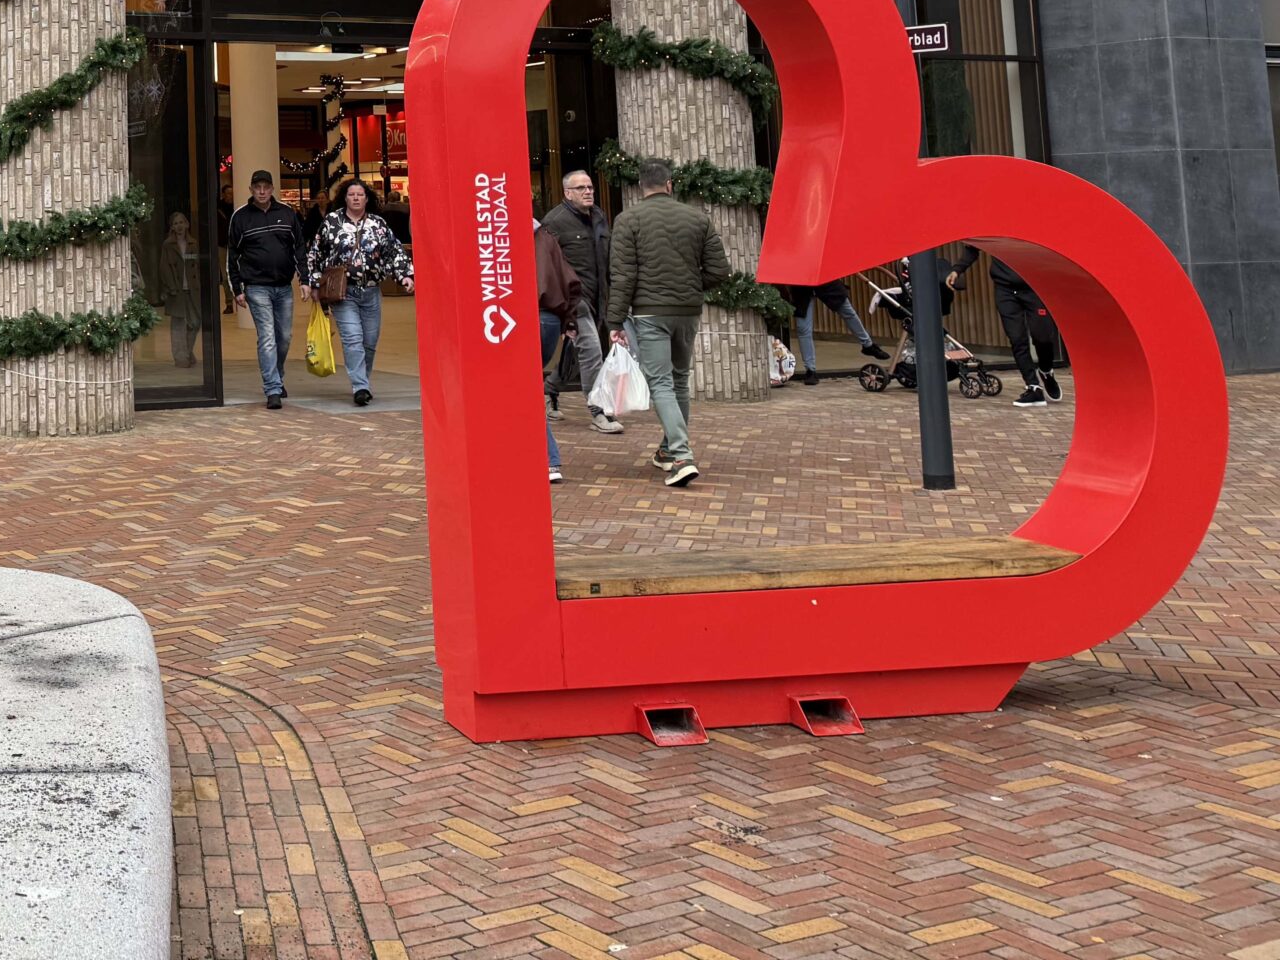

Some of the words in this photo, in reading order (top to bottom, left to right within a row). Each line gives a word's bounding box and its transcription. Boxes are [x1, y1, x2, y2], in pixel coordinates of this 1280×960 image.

[908, 31, 941, 46] rblad
[475, 173, 497, 301] WINKELSTAD
[491, 172, 513, 299] VEENENDAAL
